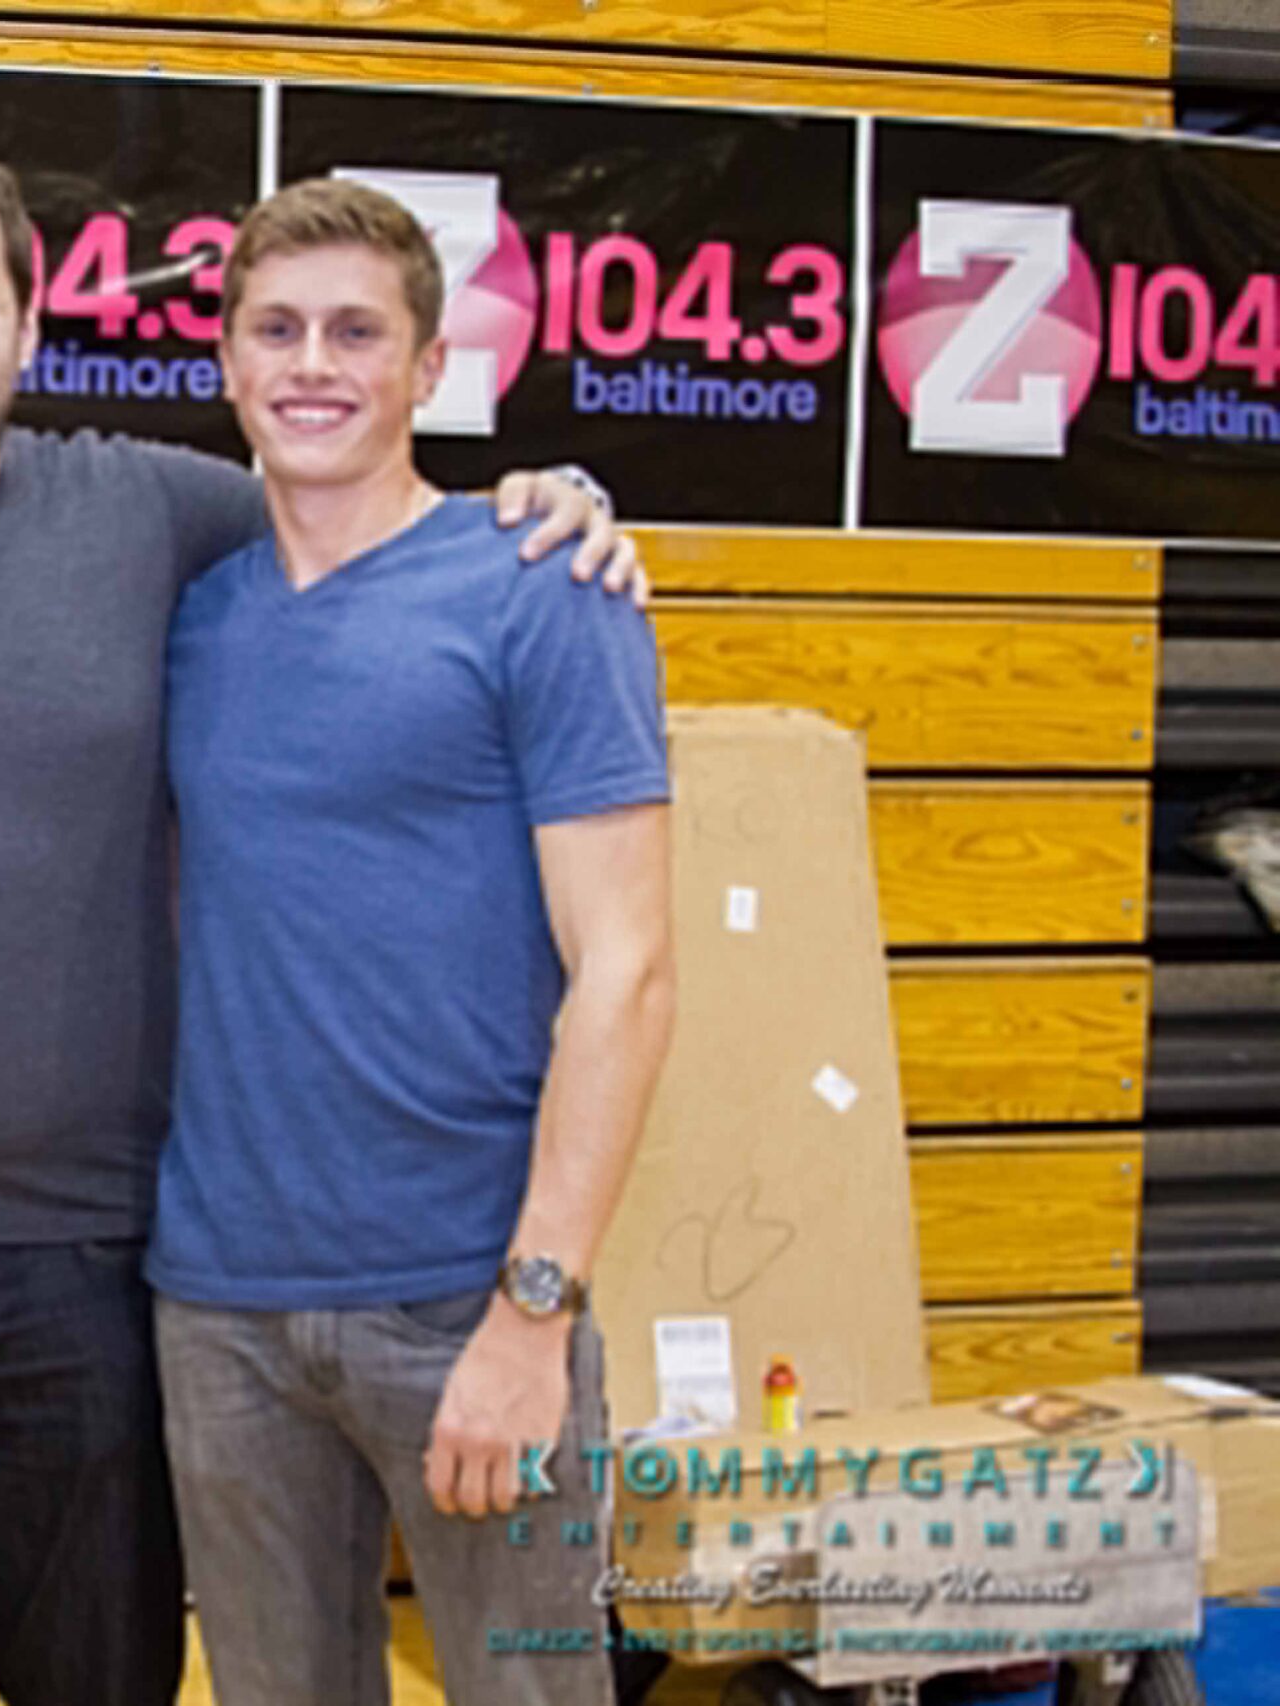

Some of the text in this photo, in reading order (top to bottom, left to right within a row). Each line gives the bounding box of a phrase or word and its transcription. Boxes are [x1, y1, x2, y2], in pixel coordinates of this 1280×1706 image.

[30, 211, 237, 341] 4.3
[543, 230, 846, 367] 104.3
[909, 197, 1073, 459] Z
[573, 359, 817, 420] baltimore
